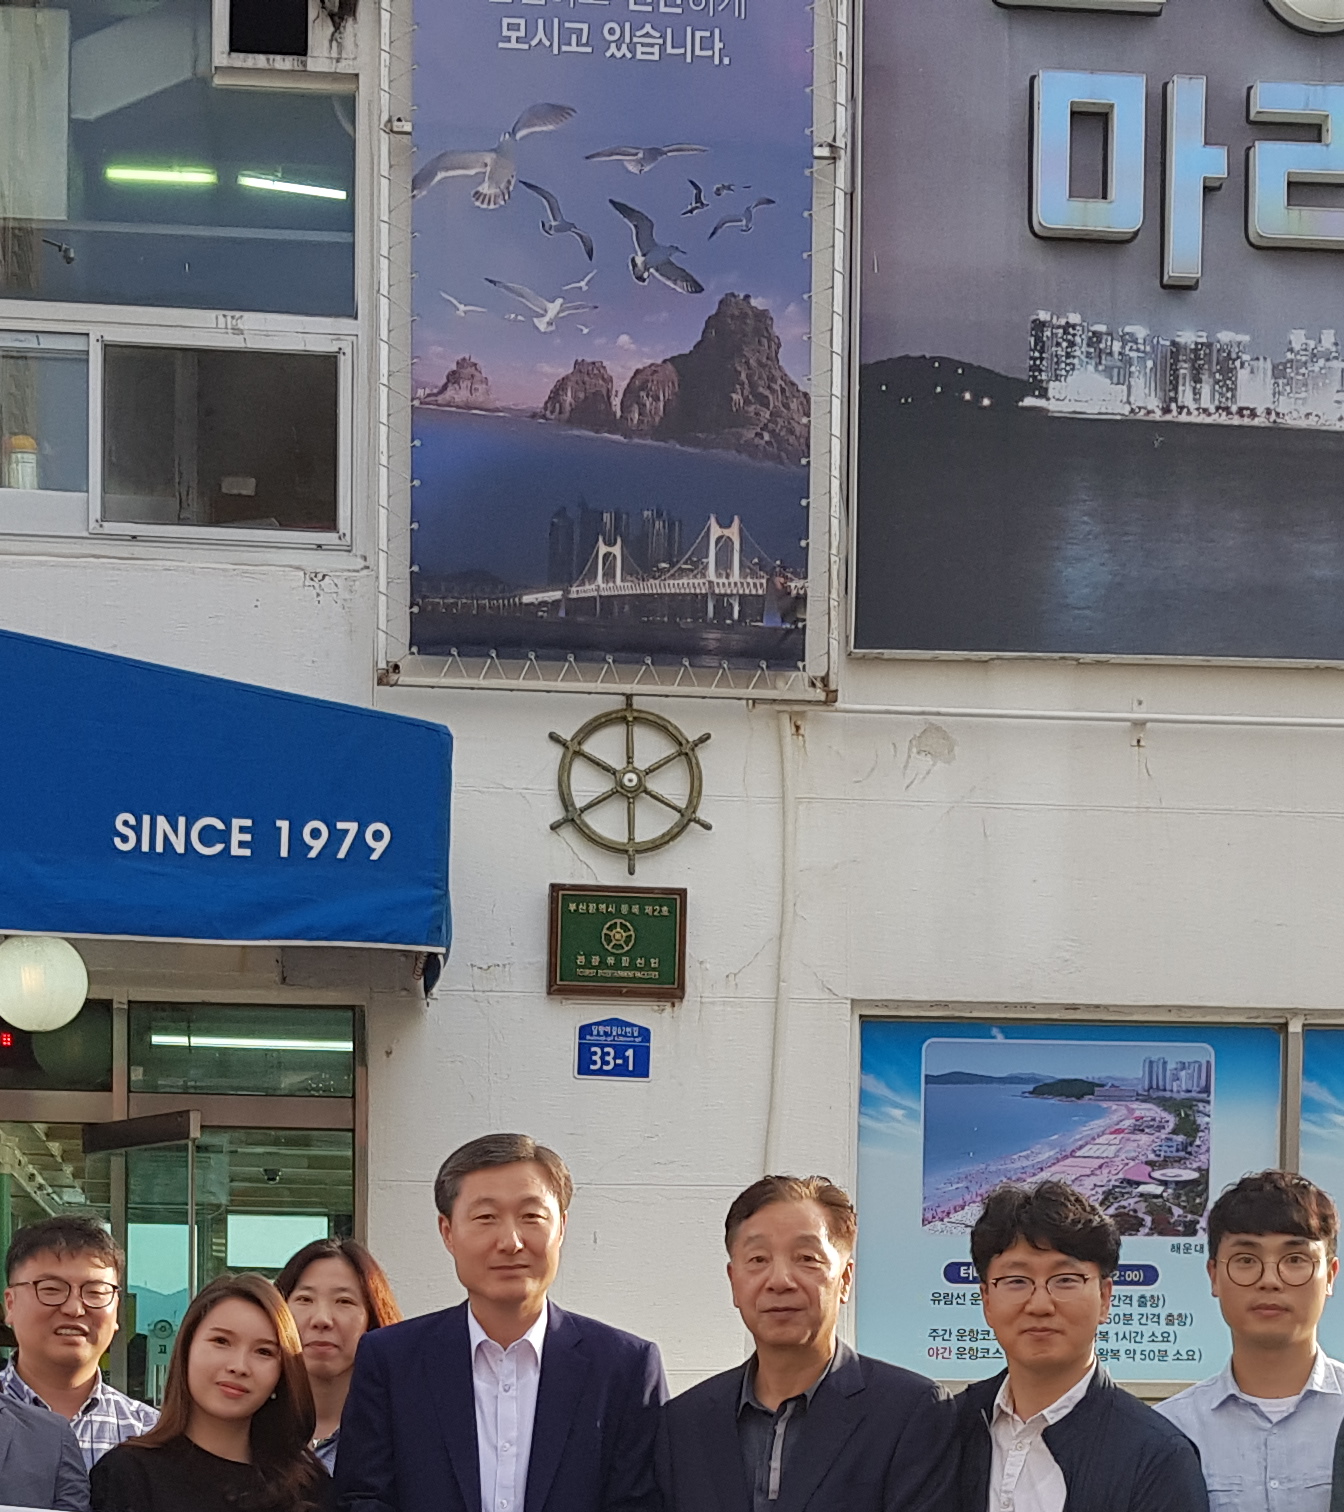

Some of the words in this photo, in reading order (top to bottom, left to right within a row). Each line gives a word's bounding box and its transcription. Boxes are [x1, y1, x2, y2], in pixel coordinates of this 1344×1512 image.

[497, 16, 593, 55] 모시고
[602, 21, 731, 65] 있습니다.
[112, 812, 254, 858] SINCE
[273, 818, 393, 862] 1979
[589, 1047, 634, 1071] 33-1
[1170, 1243, 1205, 1255] 해운대
[930, 1292, 967, 1306] 유람선
[1137, 1295, 1167, 1309] 출항)
[1137, 1313, 1162, 1326] 간격
[928, 1328, 953, 1342] 주간
[1114, 1331, 1145, 1343] 1시간
[1147, 1331, 1178, 1344] 소요)
[928, 1347, 953, 1360] 야간
[955, 1347, 1005, 1361] 운항코스
[1124, 1348, 1136, 1361] 약
[1139, 1349, 1169, 1362] 50분
[1172, 1348, 1203, 1363] 소요)
